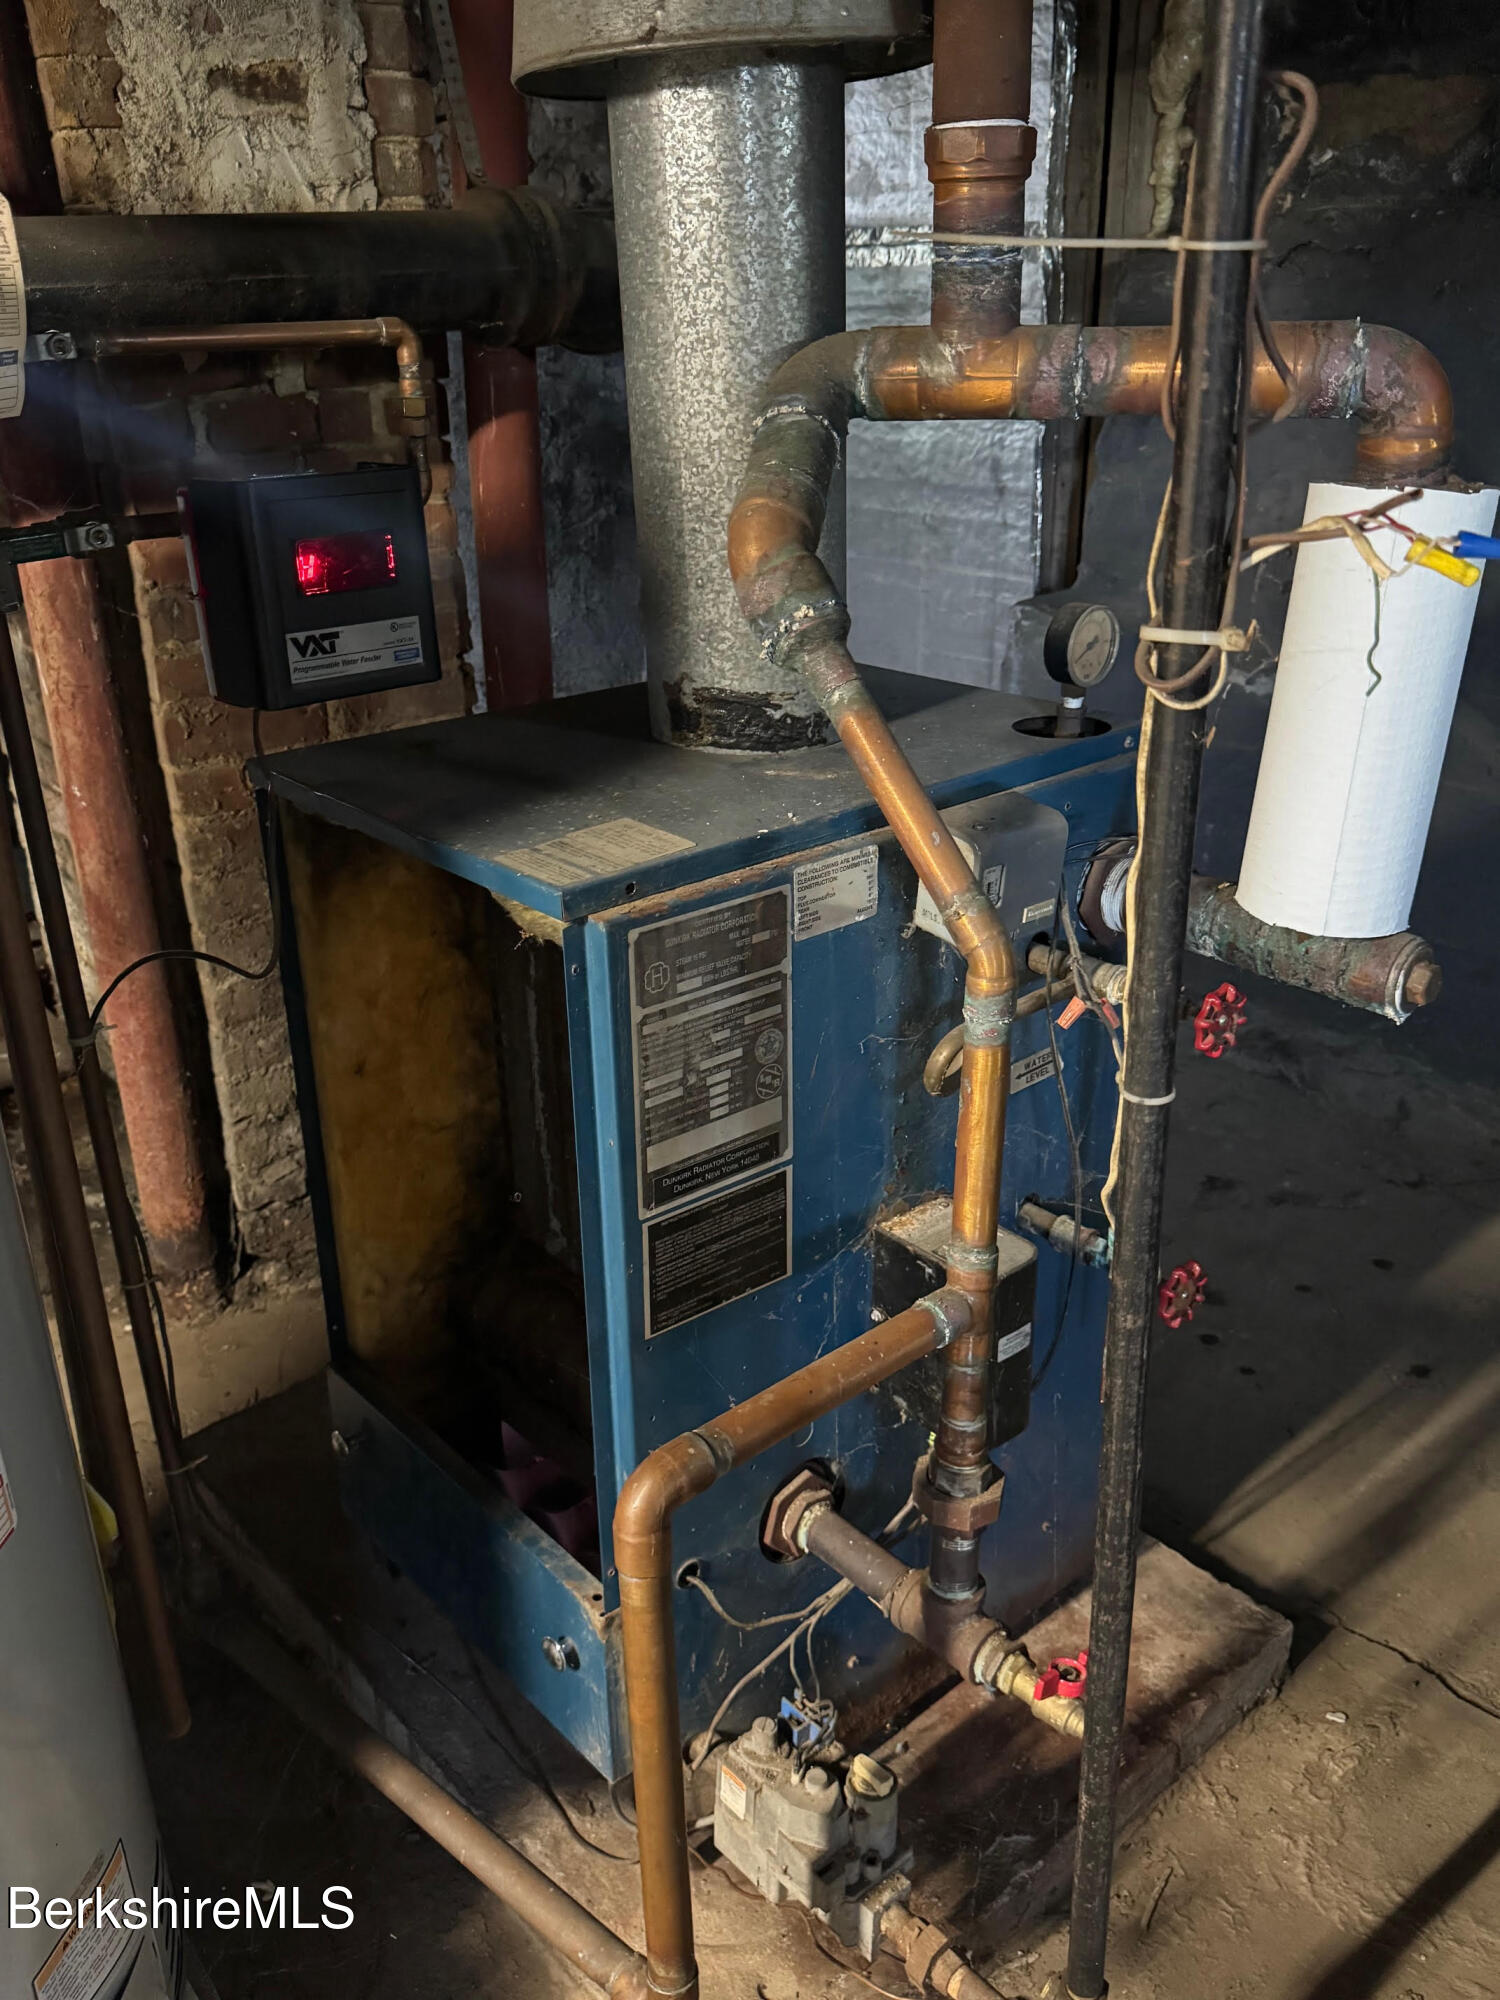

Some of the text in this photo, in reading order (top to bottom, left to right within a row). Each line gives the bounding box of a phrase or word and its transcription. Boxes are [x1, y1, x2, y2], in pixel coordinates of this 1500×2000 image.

[293, 661, 341, 674] Programmable
[342, 657, 359, 667] Water
[361, 653, 381, 664] Feeder
[797, 870, 807, 878] THE
[808, 861, 839, 875] FOLLOWING
[797, 857, 874, 886] CLEARANCES TO COMBUSTIBLE
[1025, 1067, 1050, 1083] LEVEL
[693, 1159, 725, 1174] RADIATOR
[721, 1163, 739, 1174] YORK
